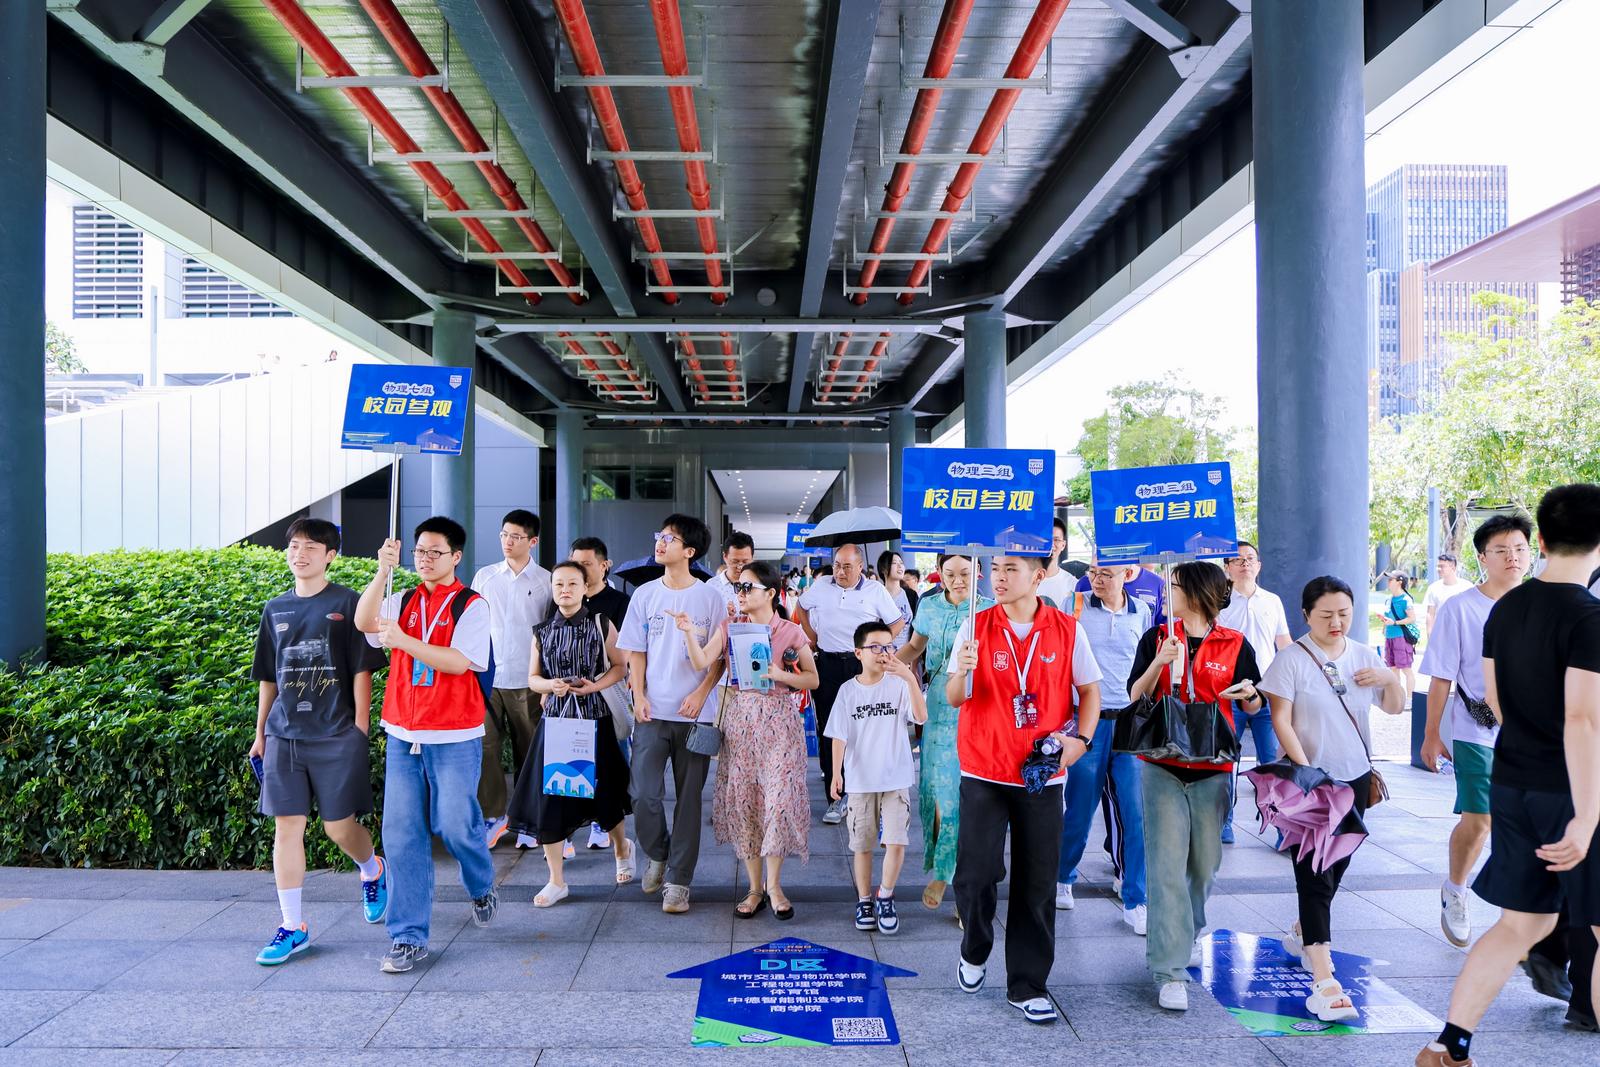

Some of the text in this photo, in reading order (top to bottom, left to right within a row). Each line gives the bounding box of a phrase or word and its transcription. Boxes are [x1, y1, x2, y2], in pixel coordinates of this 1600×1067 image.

[383, 382, 434, 396] 物理七组
[362, 396, 452, 417] 校园参观
[950, 462, 1013, 479] 物理三组
[1137, 480, 1196, 498] 物理三组
[922, 488, 1035, 511] 校园参观
[1114, 498, 1217, 525] 校园参观
[760, 958, 828, 972] D区
[721, 973, 867, 981] 城市交通与物流学院
[728, 996, 864, 1004] 中德智能制造学院
[770, 1004, 822, 1012] 商学院
